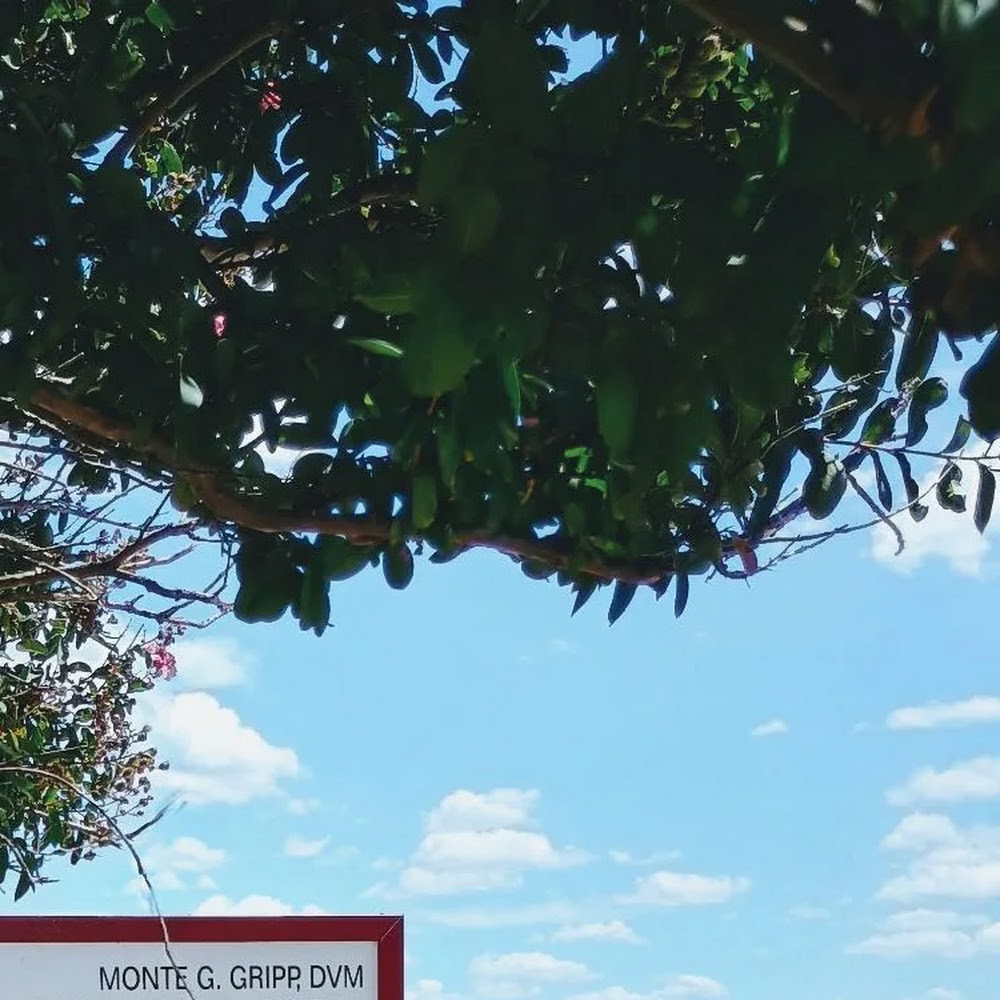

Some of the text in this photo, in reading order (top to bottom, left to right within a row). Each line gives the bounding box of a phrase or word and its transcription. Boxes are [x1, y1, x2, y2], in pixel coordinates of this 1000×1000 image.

[100, 965, 364, 992] MONTE G. GRIPP, DVM
